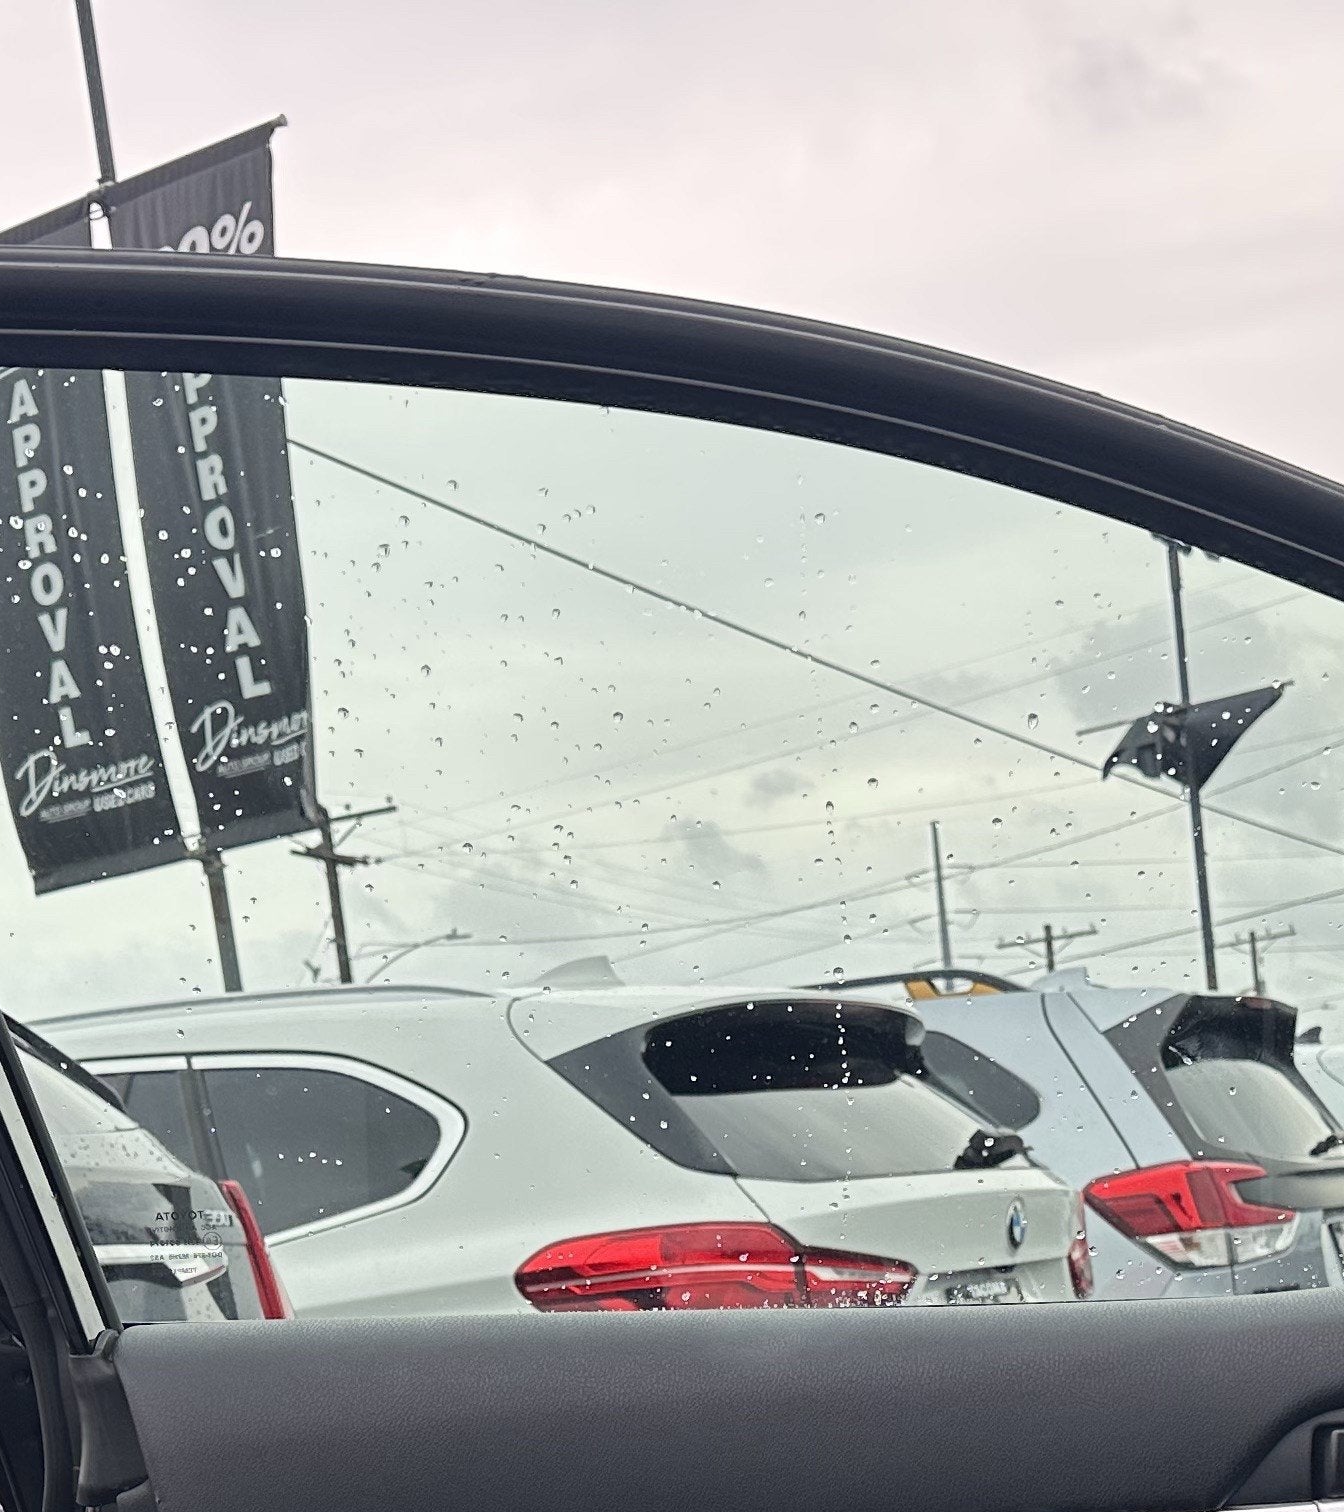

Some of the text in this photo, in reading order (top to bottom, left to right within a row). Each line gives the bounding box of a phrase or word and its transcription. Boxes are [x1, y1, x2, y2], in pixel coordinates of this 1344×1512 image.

[8, 378, 91, 748] APPROVAL
[190, 698, 308, 772] Dinsmor
[15, 750, 155, 817] Dinsmore
